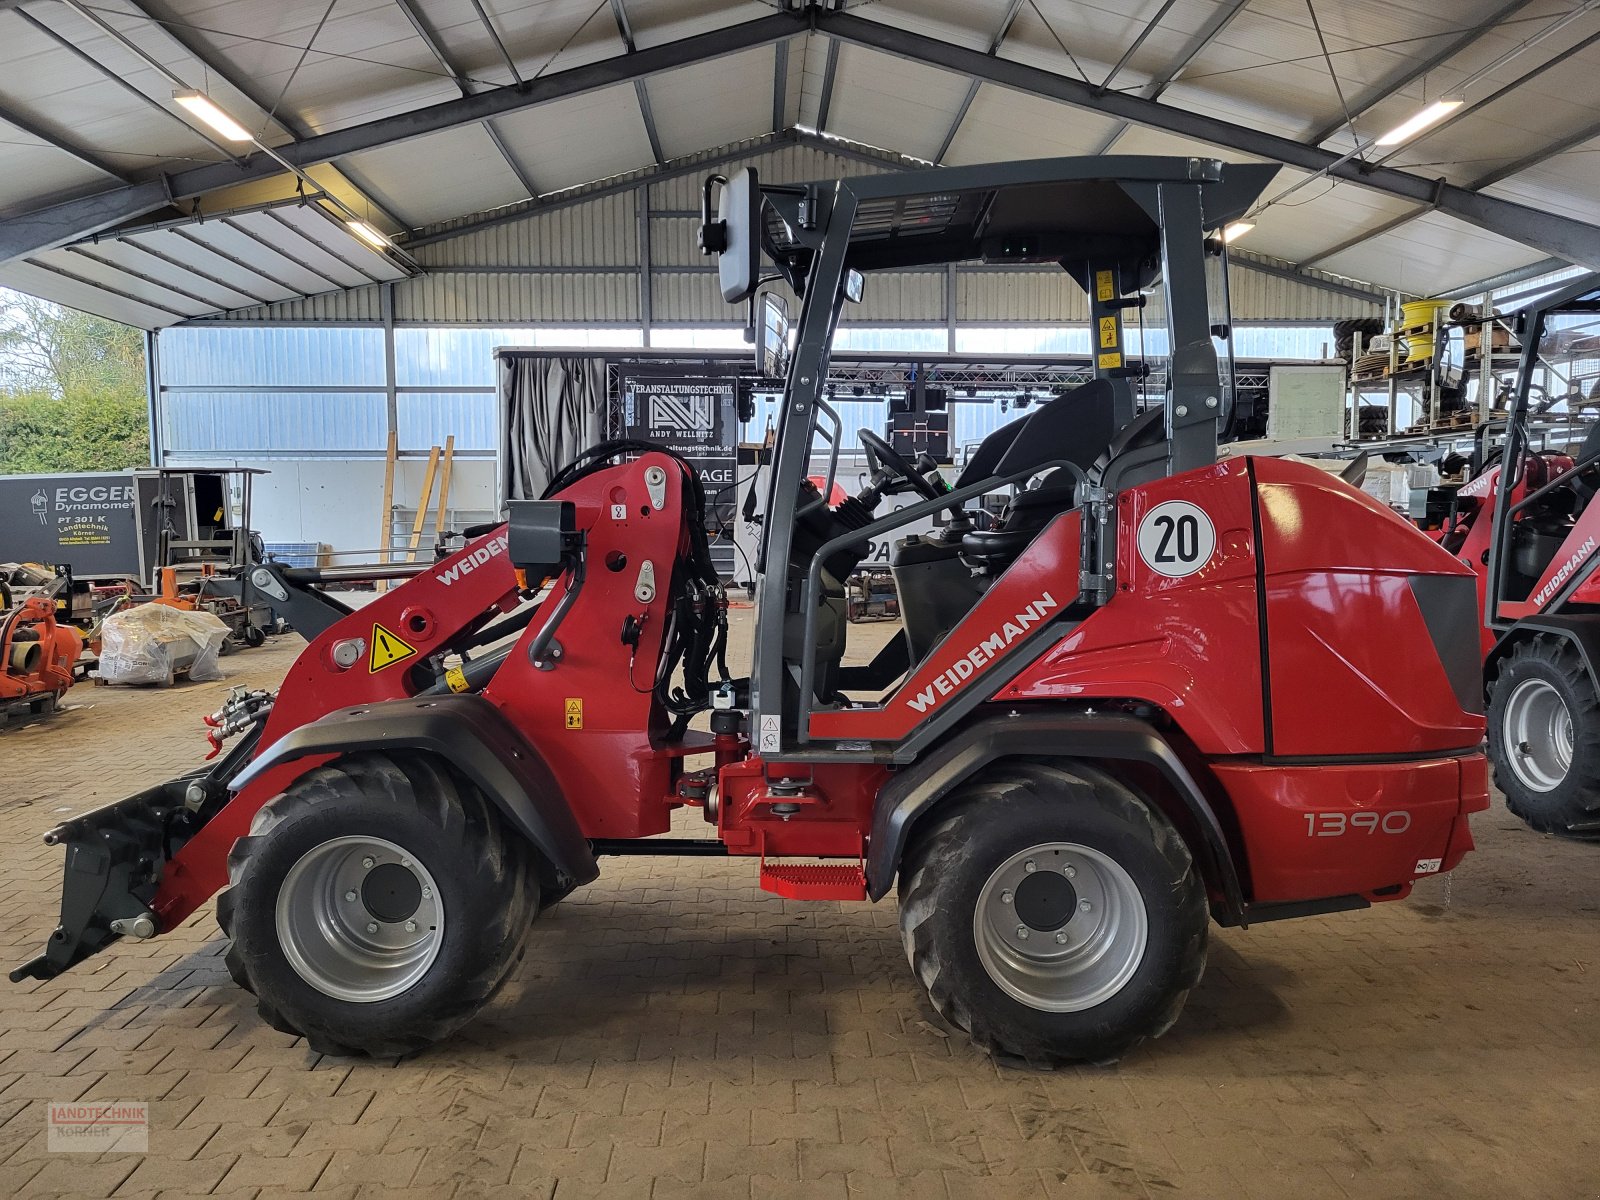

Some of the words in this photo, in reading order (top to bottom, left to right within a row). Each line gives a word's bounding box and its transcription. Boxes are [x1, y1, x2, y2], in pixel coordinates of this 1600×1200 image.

[630, 384, 733, 395] VERANSTALTUNGSTECHNIK
[650, 430, 671, 438] ANDY
[676, 430, 713, 438] WELLNITZ
[699, 469, 733, 481] AGE
[55, 486, 135, 502] EGGER
[55, 502, 135, 512] Dynamomet
[57, 516, 71, 524] PT
[97, 515, 107, 523] K
[58, 523, 109, 533] Landtechnik
[1153, 514, 1199, 563] 20
[1533, 536, 1596, 607] WEIDEMANN
[906, 591, 1058, 713] WEIDEMANN
[1303, 810, 1412, 838] 1390
